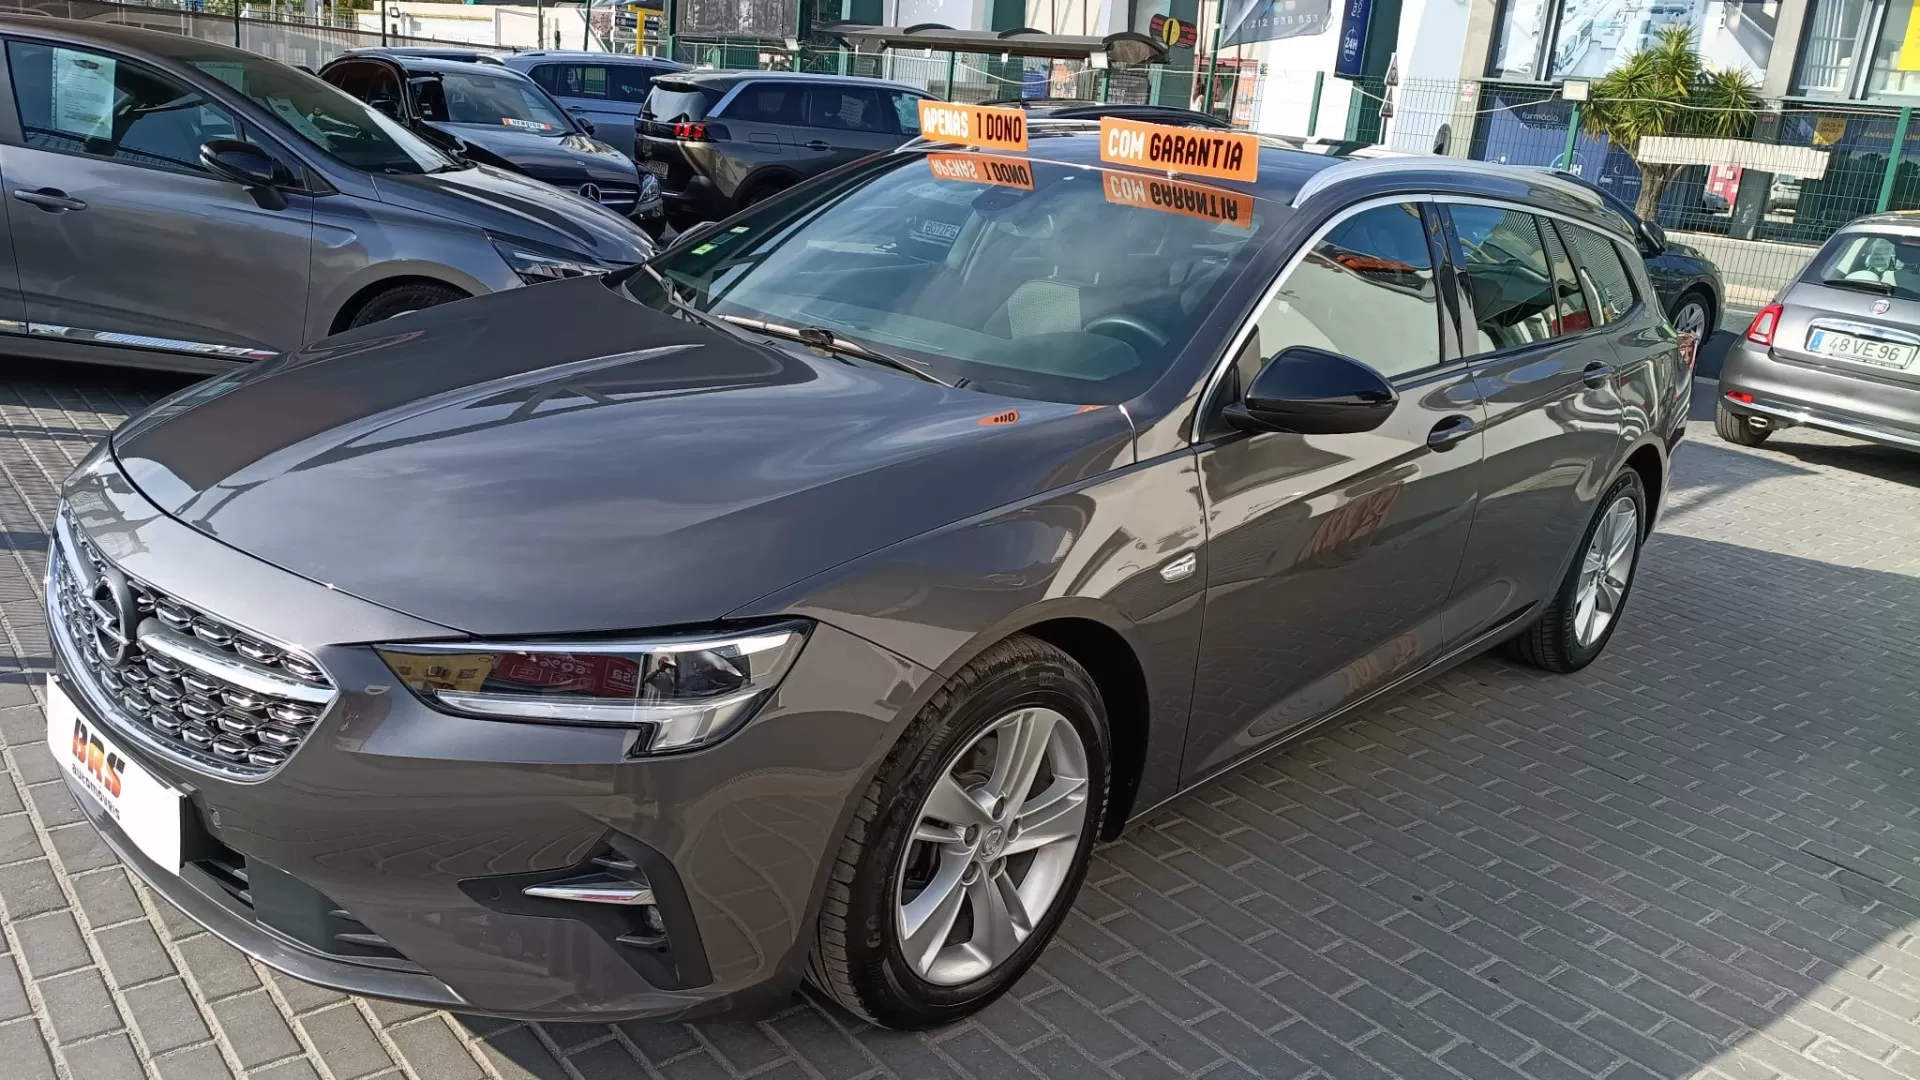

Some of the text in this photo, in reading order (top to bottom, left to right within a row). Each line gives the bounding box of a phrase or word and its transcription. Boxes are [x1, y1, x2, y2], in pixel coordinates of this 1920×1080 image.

[1344, 37, 1358, 50] 24H
[923, 107, 1022, 143] APENAS 1 DONO
[1108, 127, 1243, 172] COM GARANTIA
[72, 717, 126, 799] BRS
[72, 763, 121, 821] automóveis
